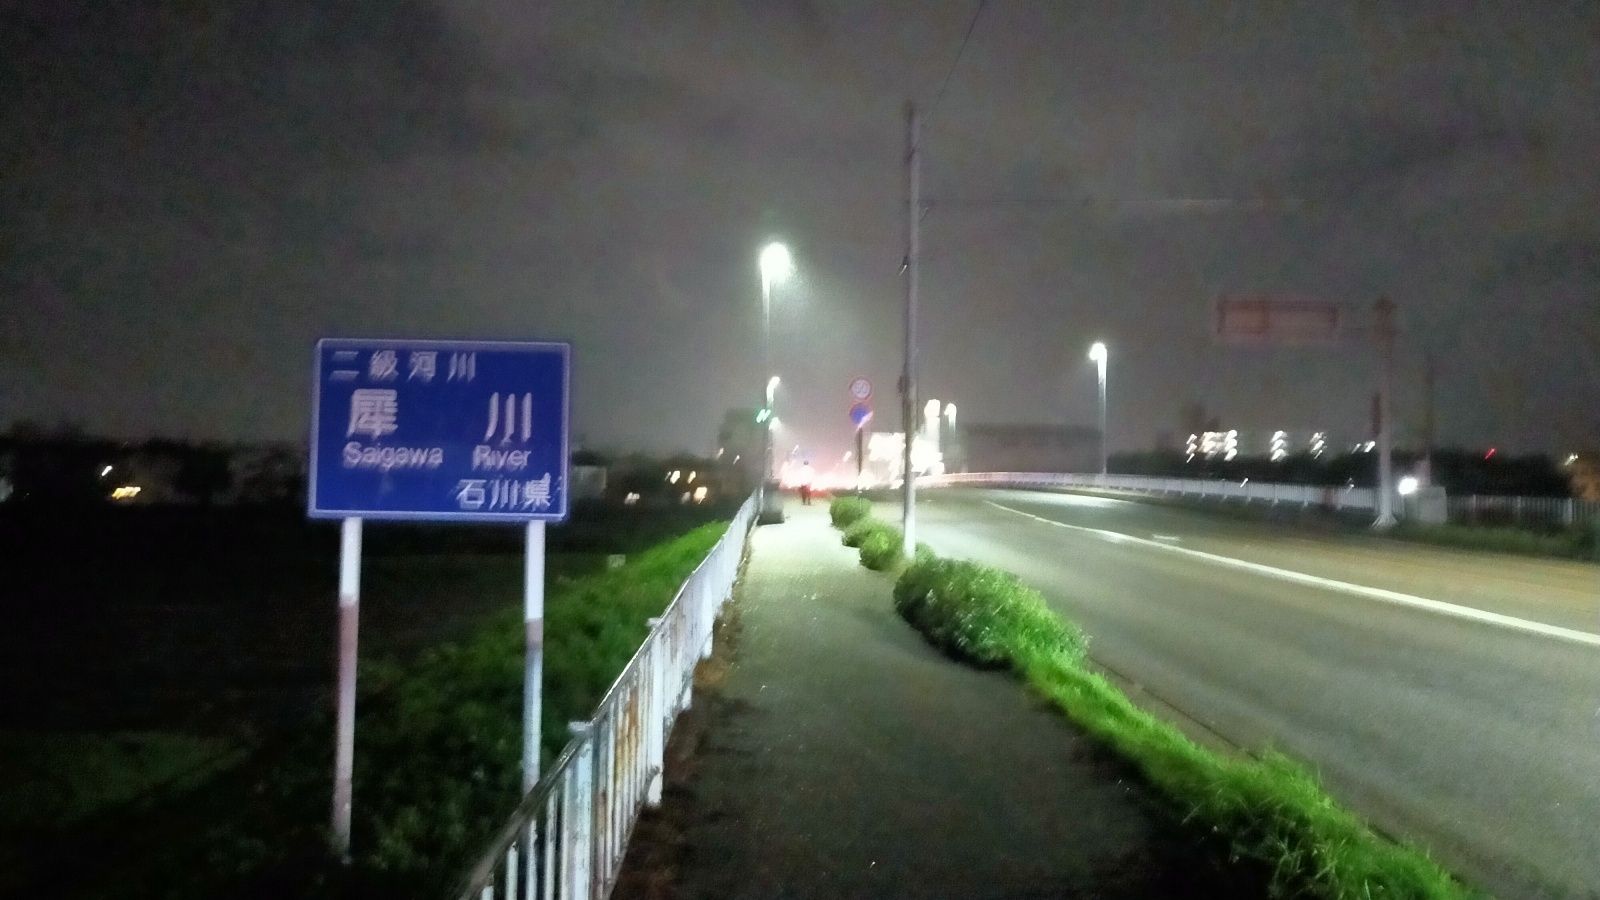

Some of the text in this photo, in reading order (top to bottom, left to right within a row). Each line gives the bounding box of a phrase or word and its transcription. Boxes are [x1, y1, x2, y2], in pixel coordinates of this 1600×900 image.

[331, 350, 477, 382] 二級河川
[343, 441, 532, 471] Saigawa River
[456, 475, 551, 511] 石川県
